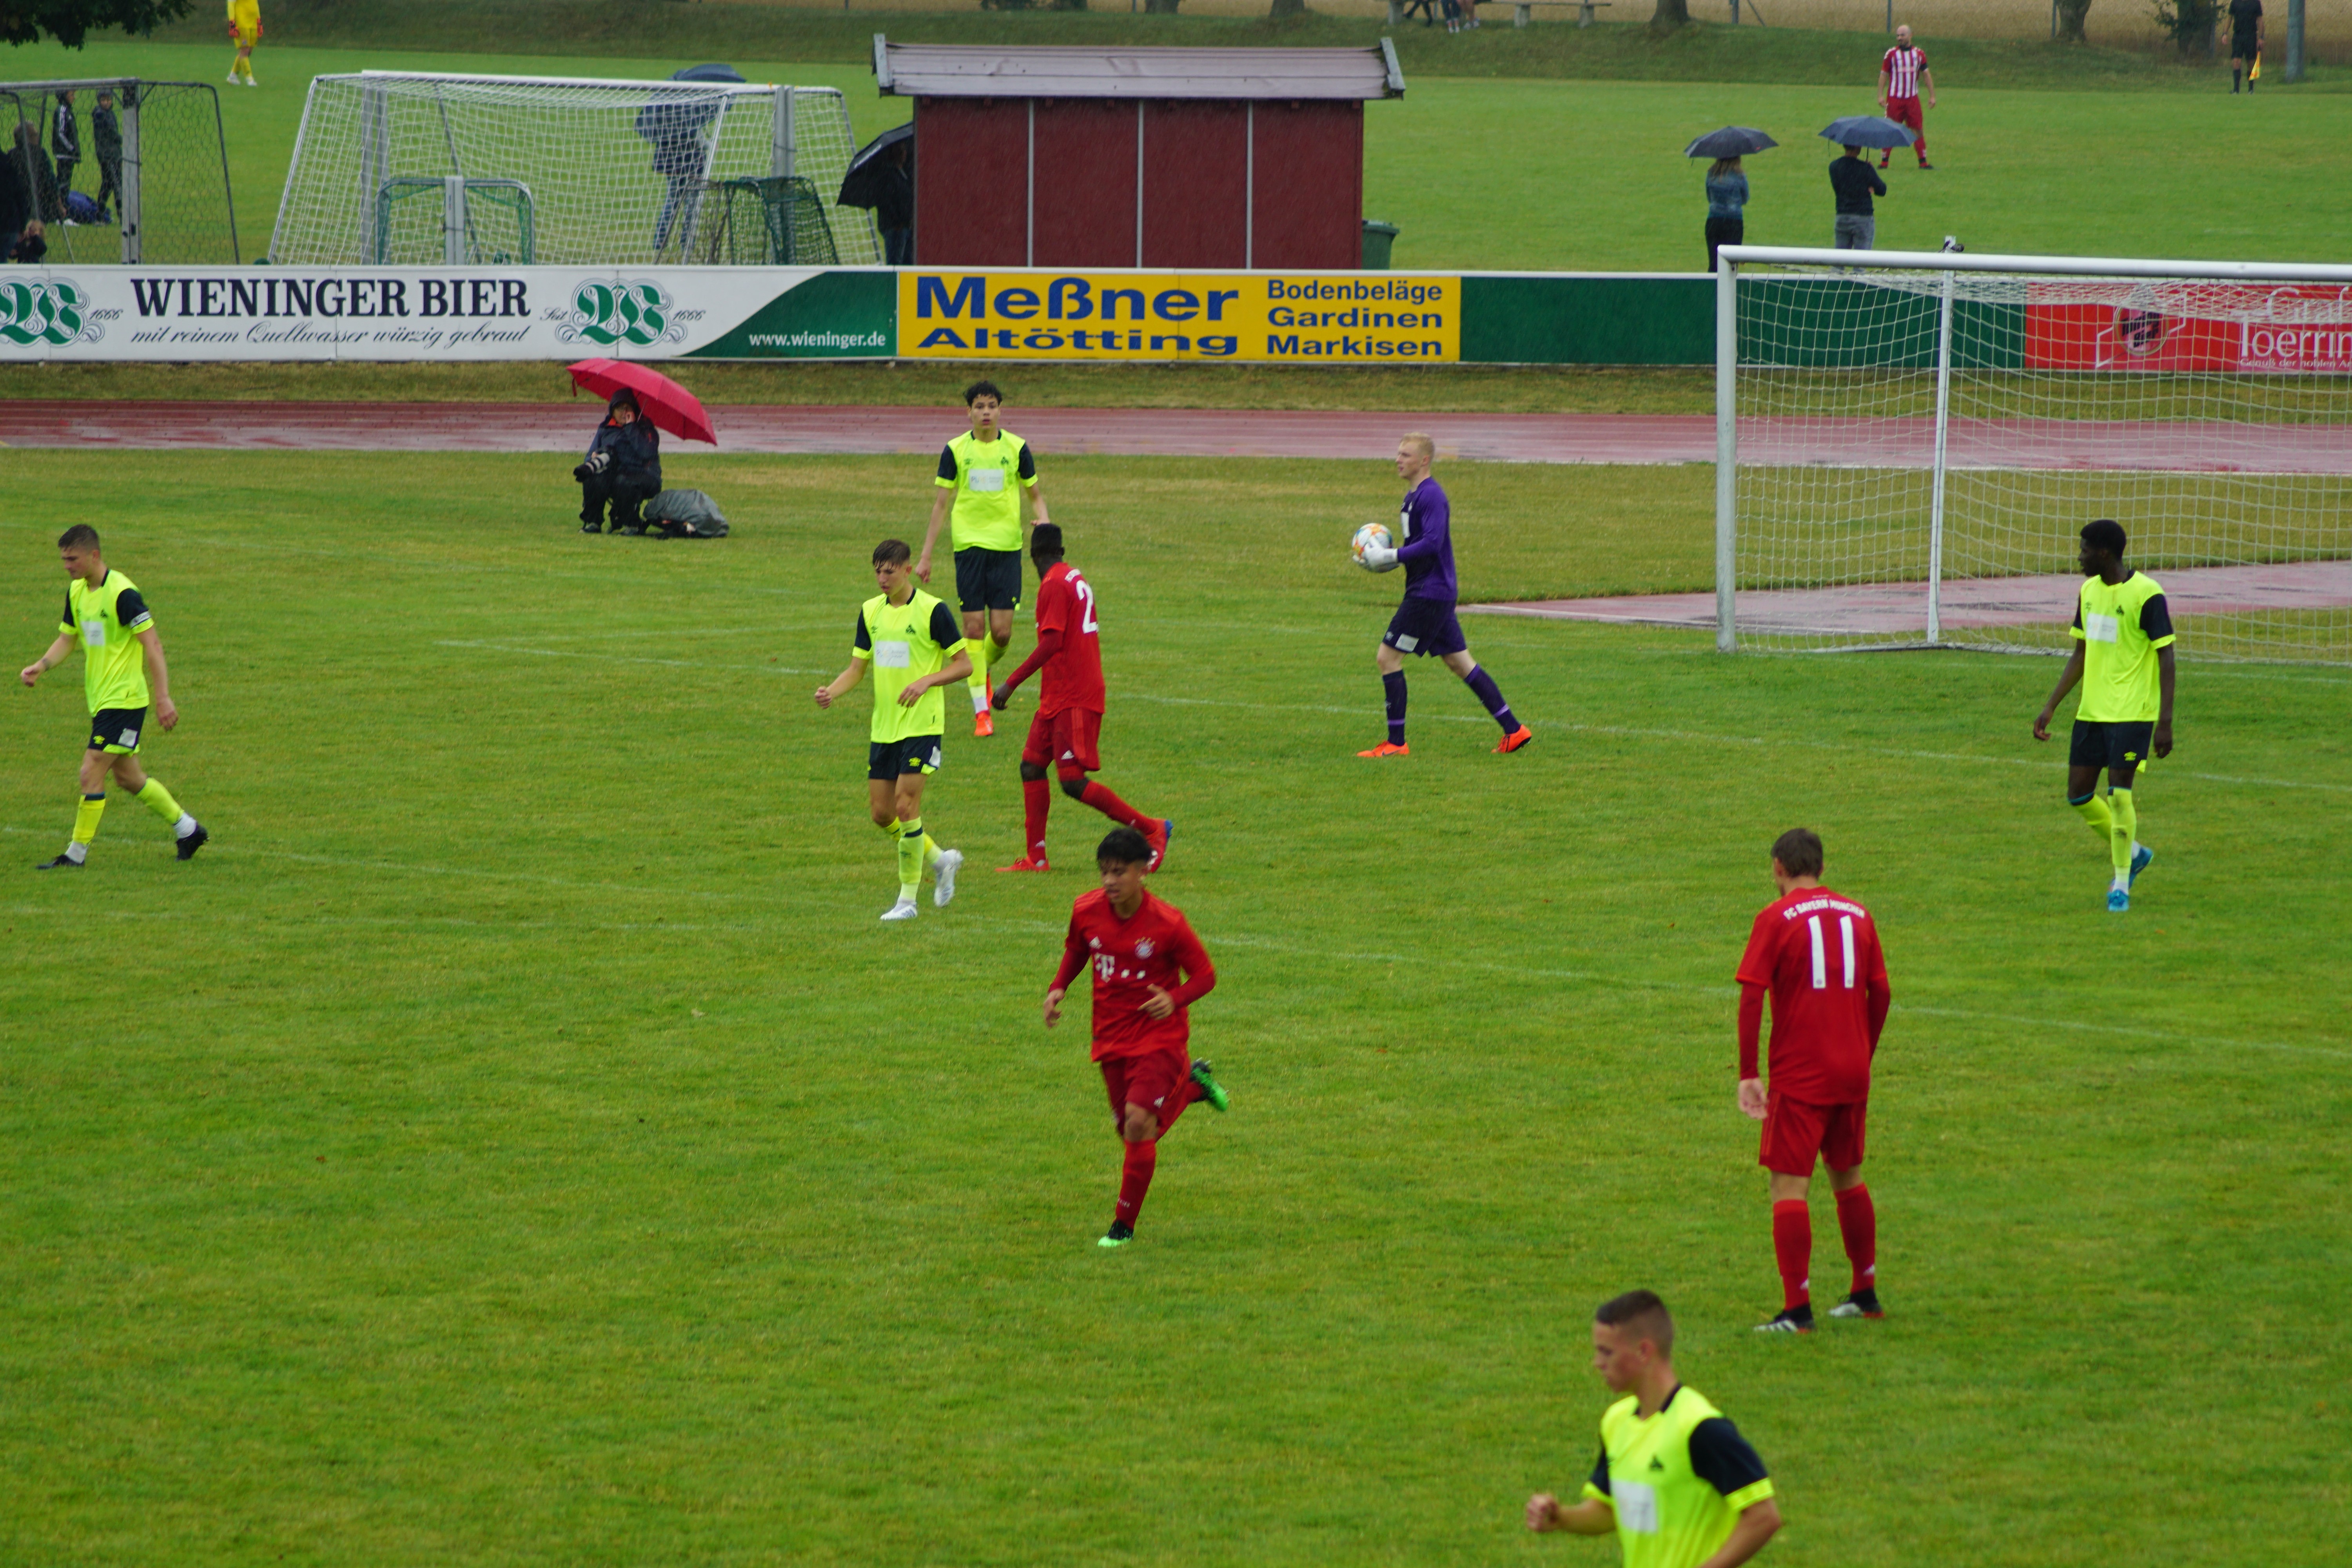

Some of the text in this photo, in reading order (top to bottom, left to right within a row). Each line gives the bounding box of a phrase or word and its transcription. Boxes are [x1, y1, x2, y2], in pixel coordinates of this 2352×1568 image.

[131, 278, 531, 318] WIENINGER BIER
[916, 276, 1239, 321] Meßner
[1267, 279, 1442, 305] Bodenbeläge
[539, 307, 568, 321] Seit
[672, 309, 706, 321] 1666
[1267, 306, 1442, 328] Gardinen
[131, 321, 532, 350] mit reinem Quellwasser würzig gebraut
[749, 330, 886, 349] www.wieninger.de
[916, 328, 1238, 356] Altötting
[1267, 335, 1442, 357] Markisen
[1783, 907, 1798, 920] FC
[1808, 915, 1855, 989] 11
